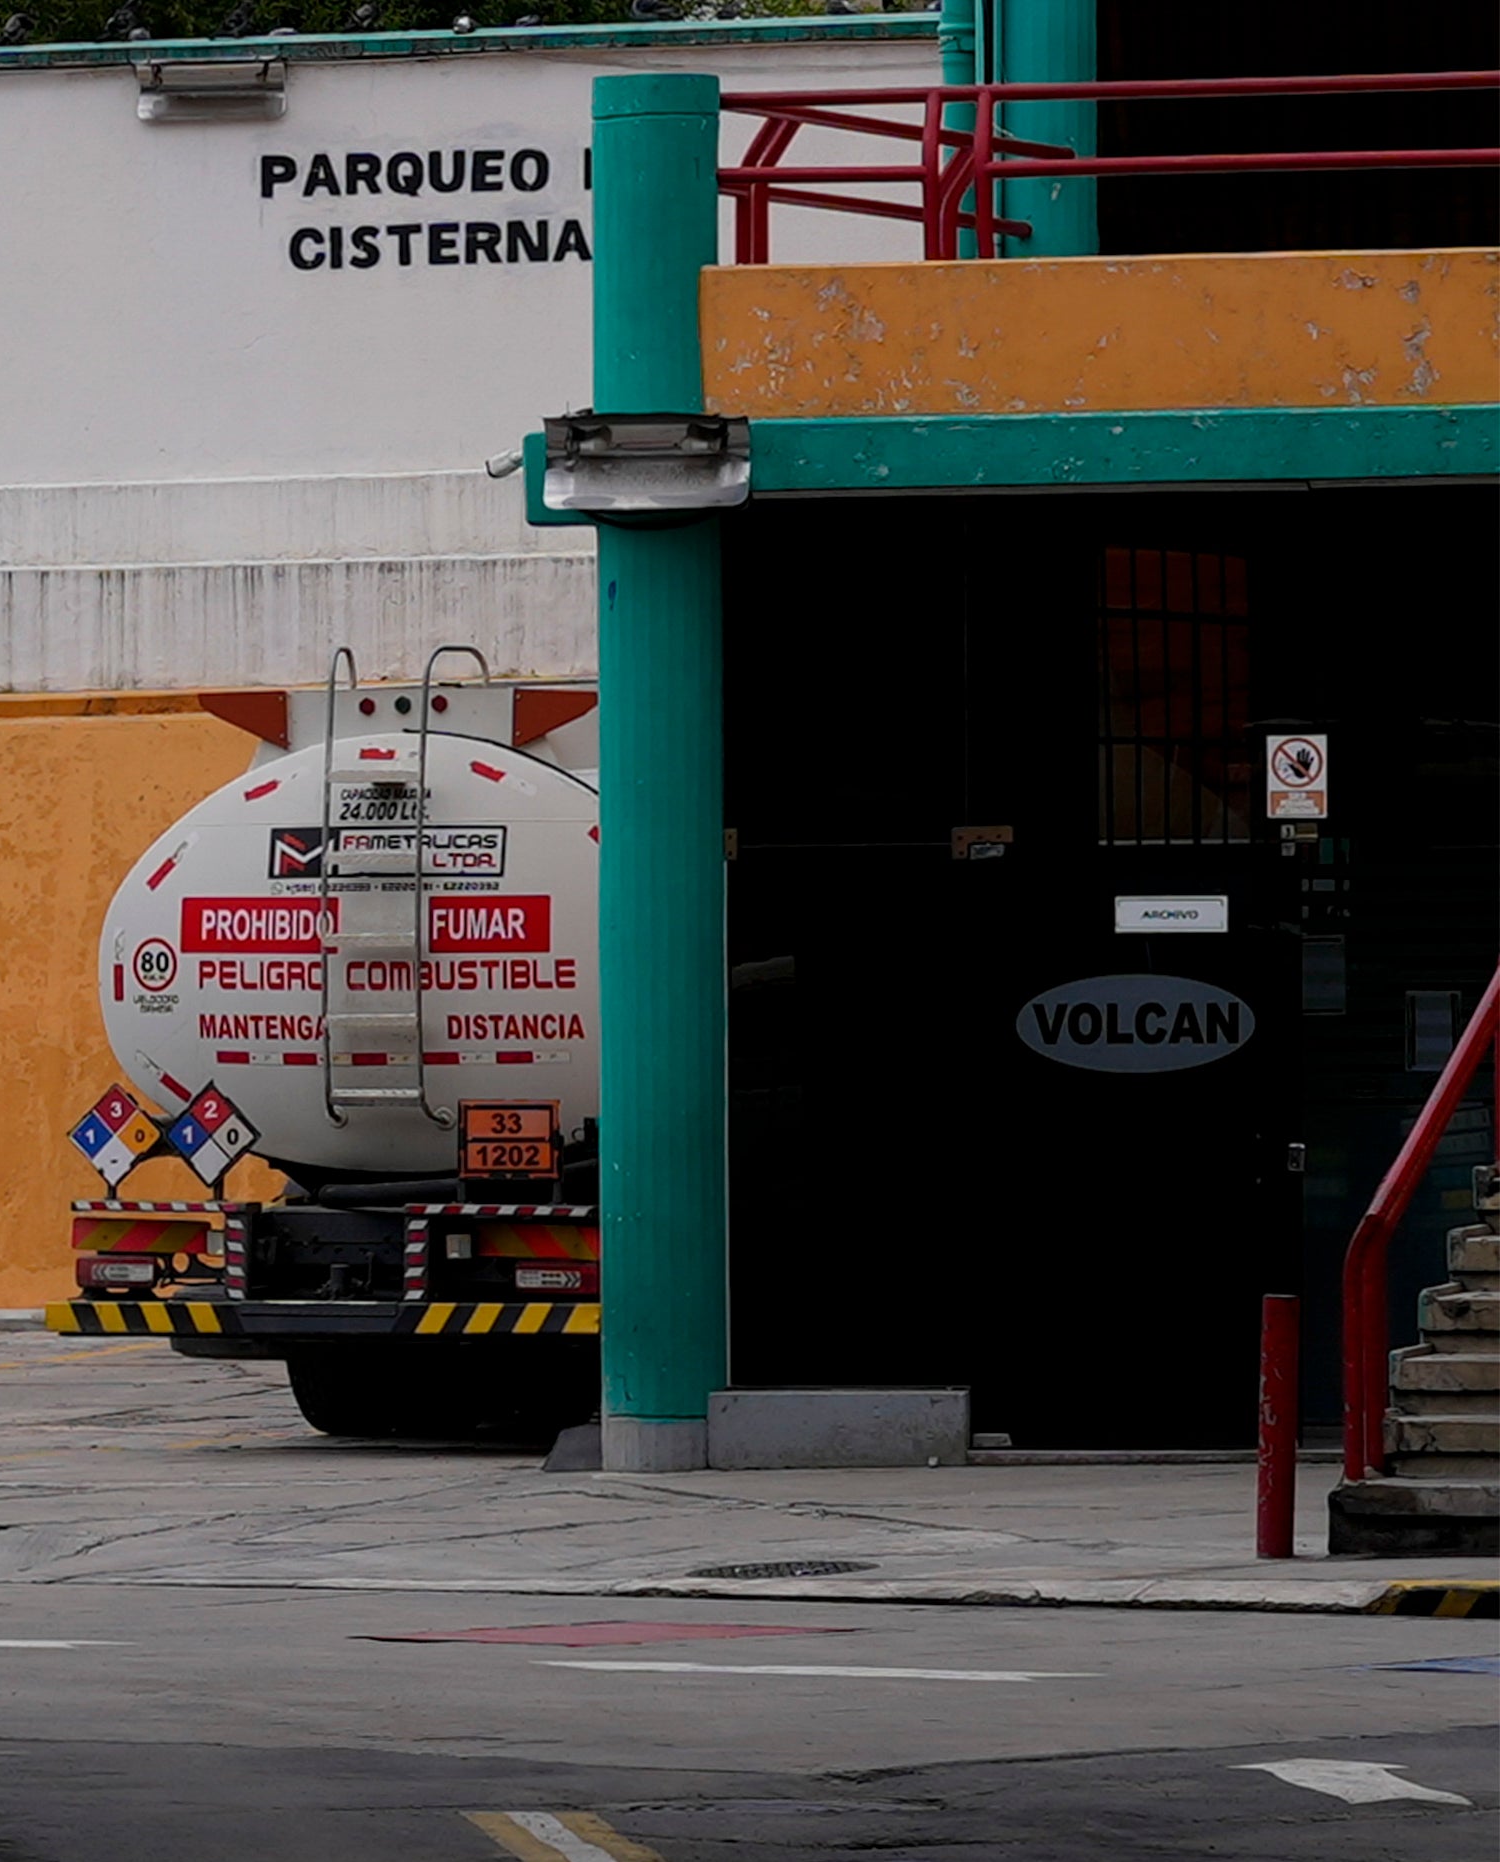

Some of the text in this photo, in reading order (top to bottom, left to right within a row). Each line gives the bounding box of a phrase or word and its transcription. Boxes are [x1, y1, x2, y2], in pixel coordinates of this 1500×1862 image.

[261, 149, 549, 198] PARQUEO
[340, 802, 398, 820] 24.000
[200, 907, 526, 941] PROHIBIDO FUMAR
[141, 952, 169, 973] 80
[346, 958, 576, 991] COMBUSTIBLE
[447, 1013, 584, 1040] DISTANCIA
[1032, 1001, 1240, 1046] VOLCAN
[109, 1102, 124, 1118] 3
[203, 1100, 218, 1119] 2
[490, 1112, 522, 1135] 33
[85, 1129, 145, 1145] 1 0
[182, 1126, 239, 1146] 1 0
[474, 1144, 540, 1167] 1202
